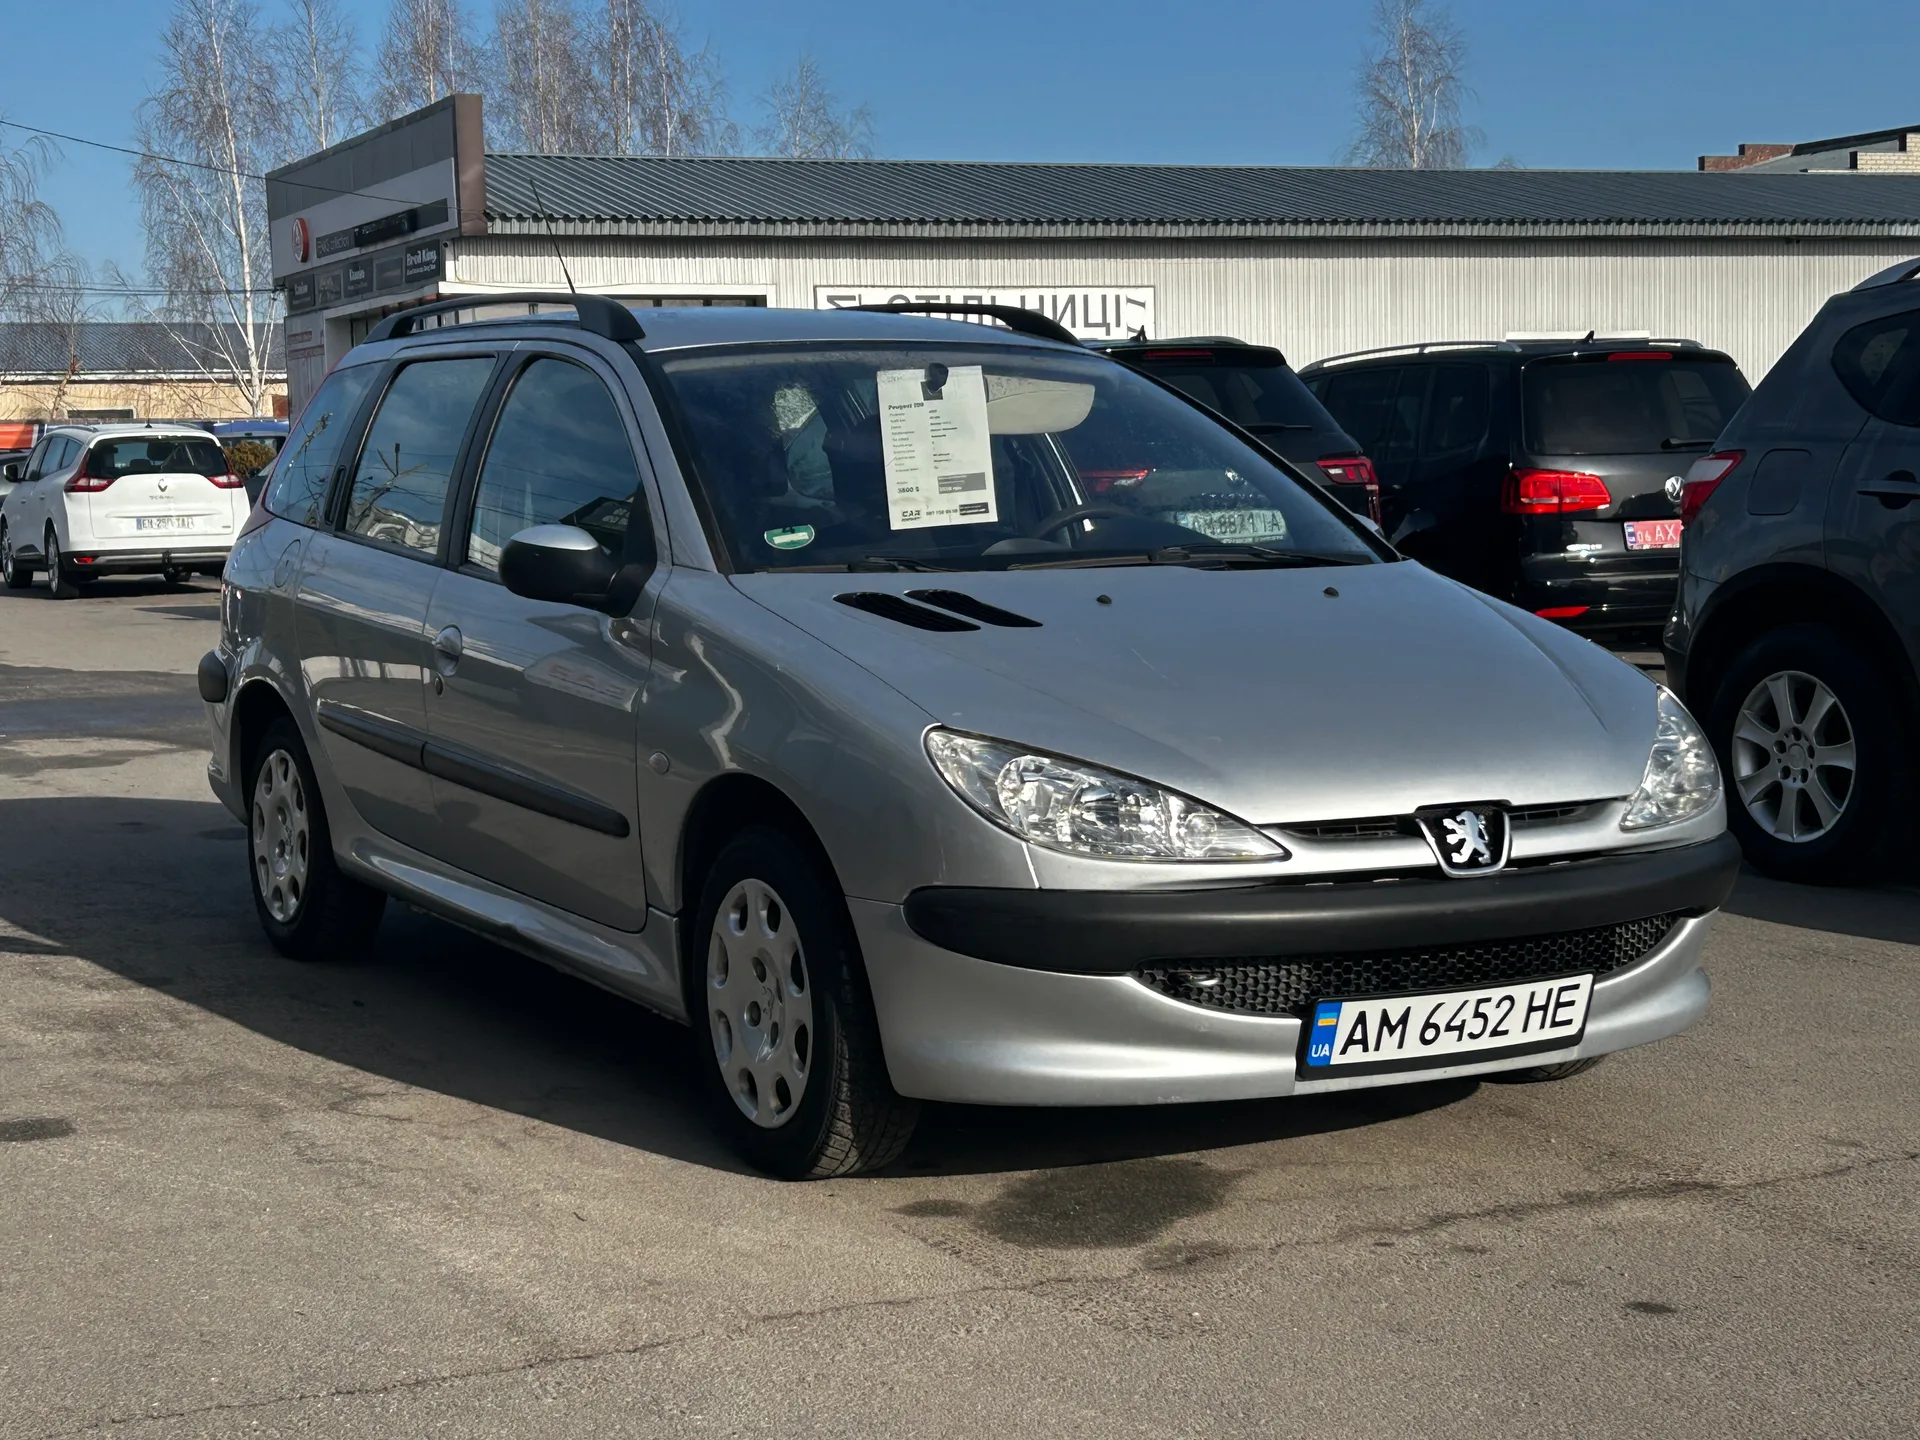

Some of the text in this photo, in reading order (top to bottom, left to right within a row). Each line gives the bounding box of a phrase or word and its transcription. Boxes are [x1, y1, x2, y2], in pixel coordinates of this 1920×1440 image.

[887, 295, 1121, 336] ТІЛЬНИЦІ
[1339, 983, 1581, 1056] AM 6452 HE
[1311, 1042, 1331, 1058] UA
